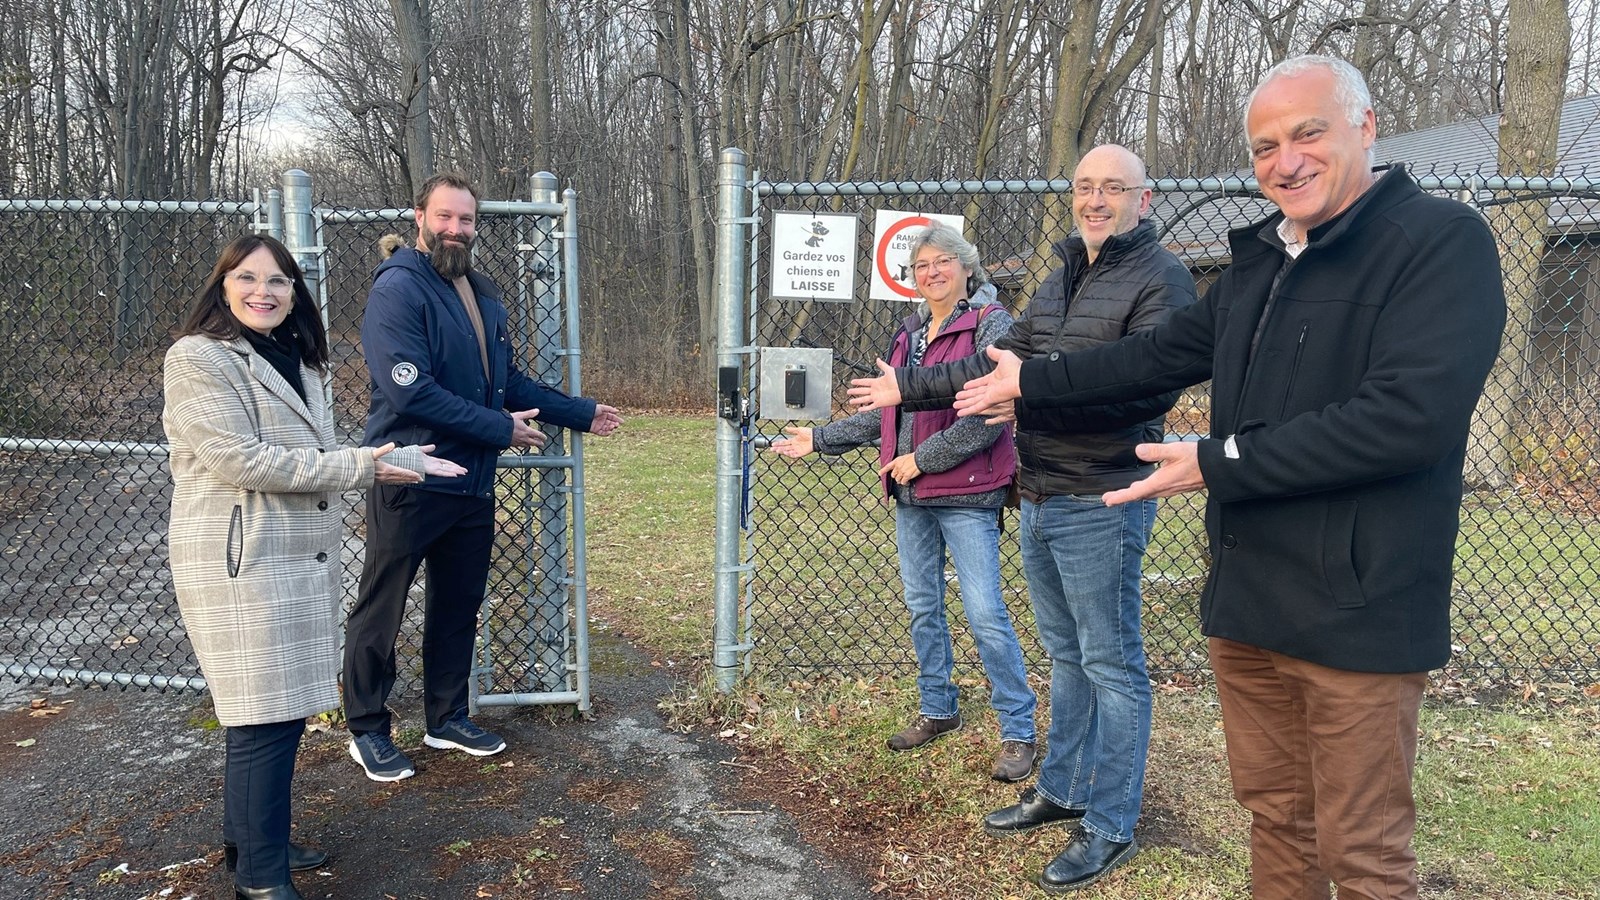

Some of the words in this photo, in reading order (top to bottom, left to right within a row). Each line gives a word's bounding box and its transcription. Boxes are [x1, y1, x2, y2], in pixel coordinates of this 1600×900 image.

[783, 250, 823, 262] Gardez
[826, 254, 846, 262] vos
[786, 265, 824, 276] chiens
[826, 269, 840, 277] en
[791, 281, 835, 291] LAISSE
